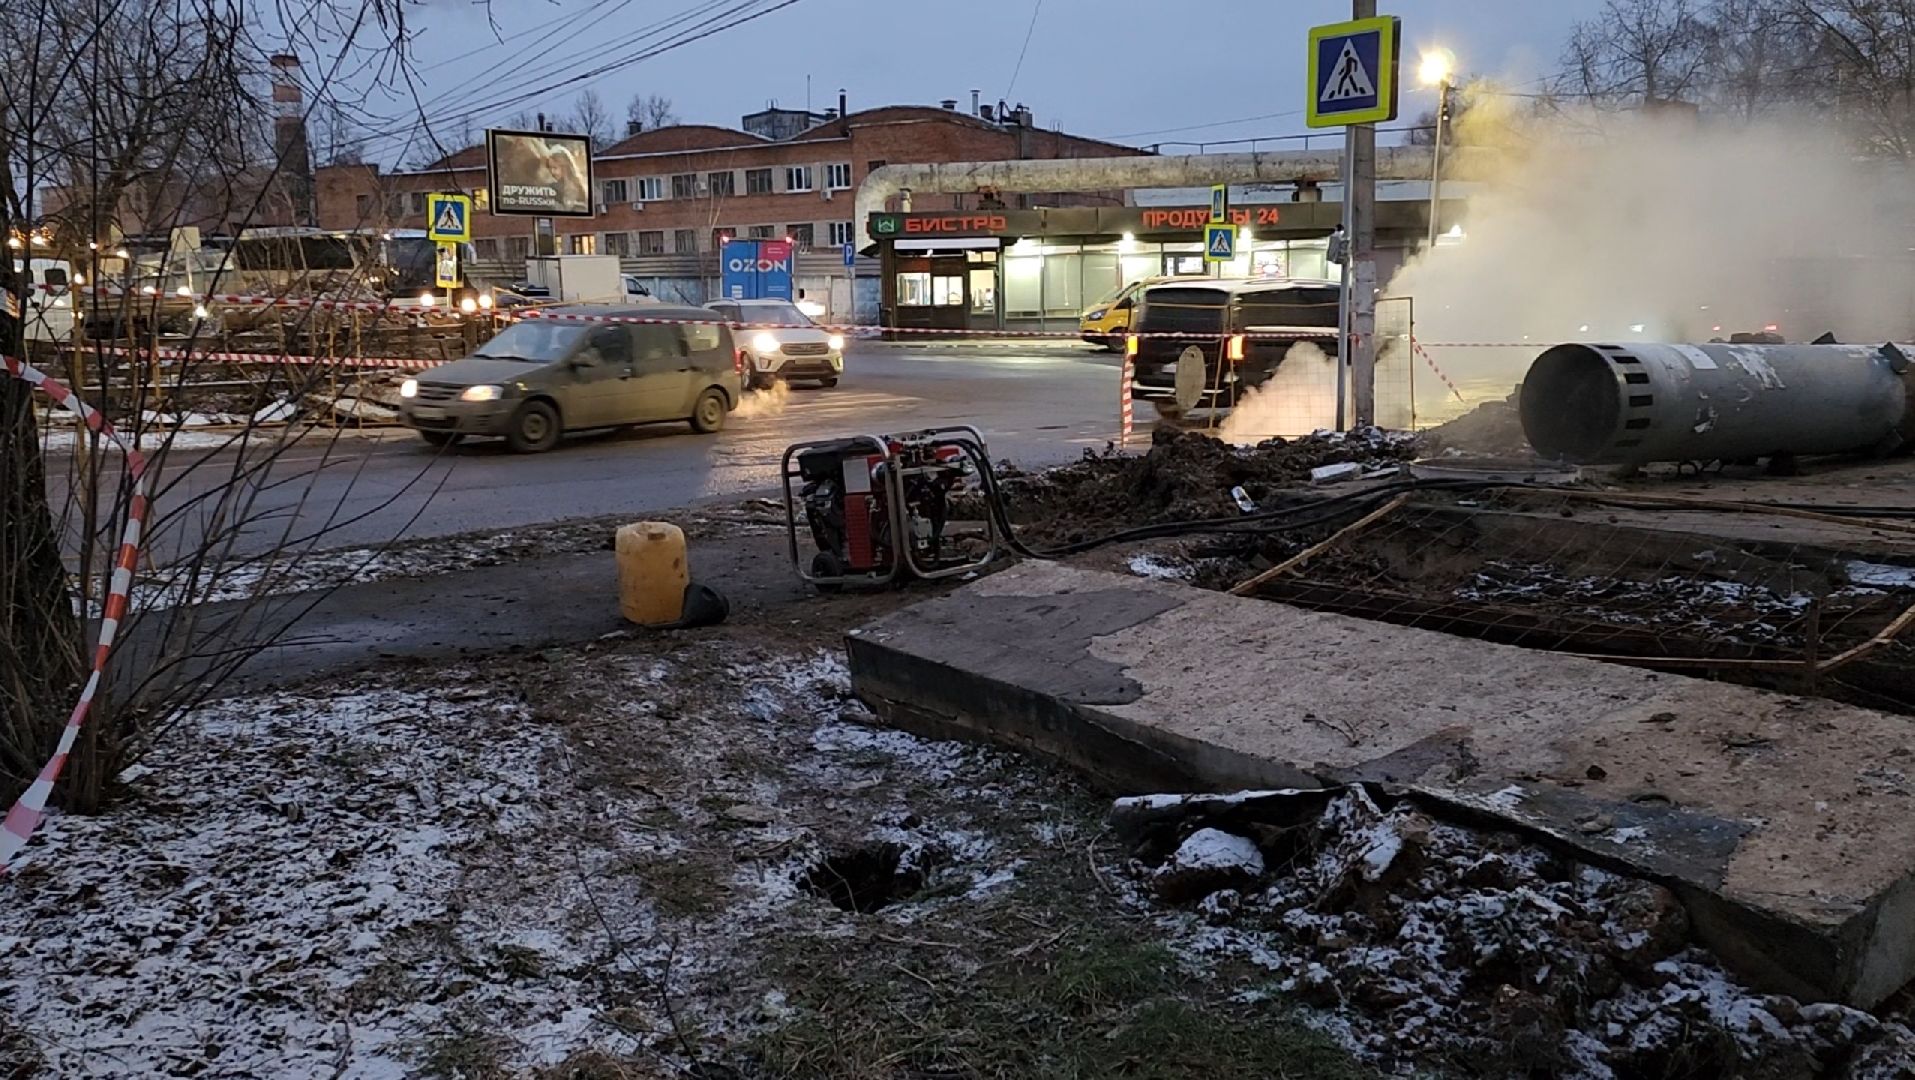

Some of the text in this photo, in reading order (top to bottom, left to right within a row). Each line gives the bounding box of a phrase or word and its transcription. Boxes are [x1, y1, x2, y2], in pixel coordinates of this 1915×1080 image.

[502, 185, 557, 196] ДРУЖИТЬ
[905, 216, 1007, 232] БИСТРО
[1142, 208, 1280, 228] ПРОДУЫ 24
[729, 258, 787, 272] OZON
